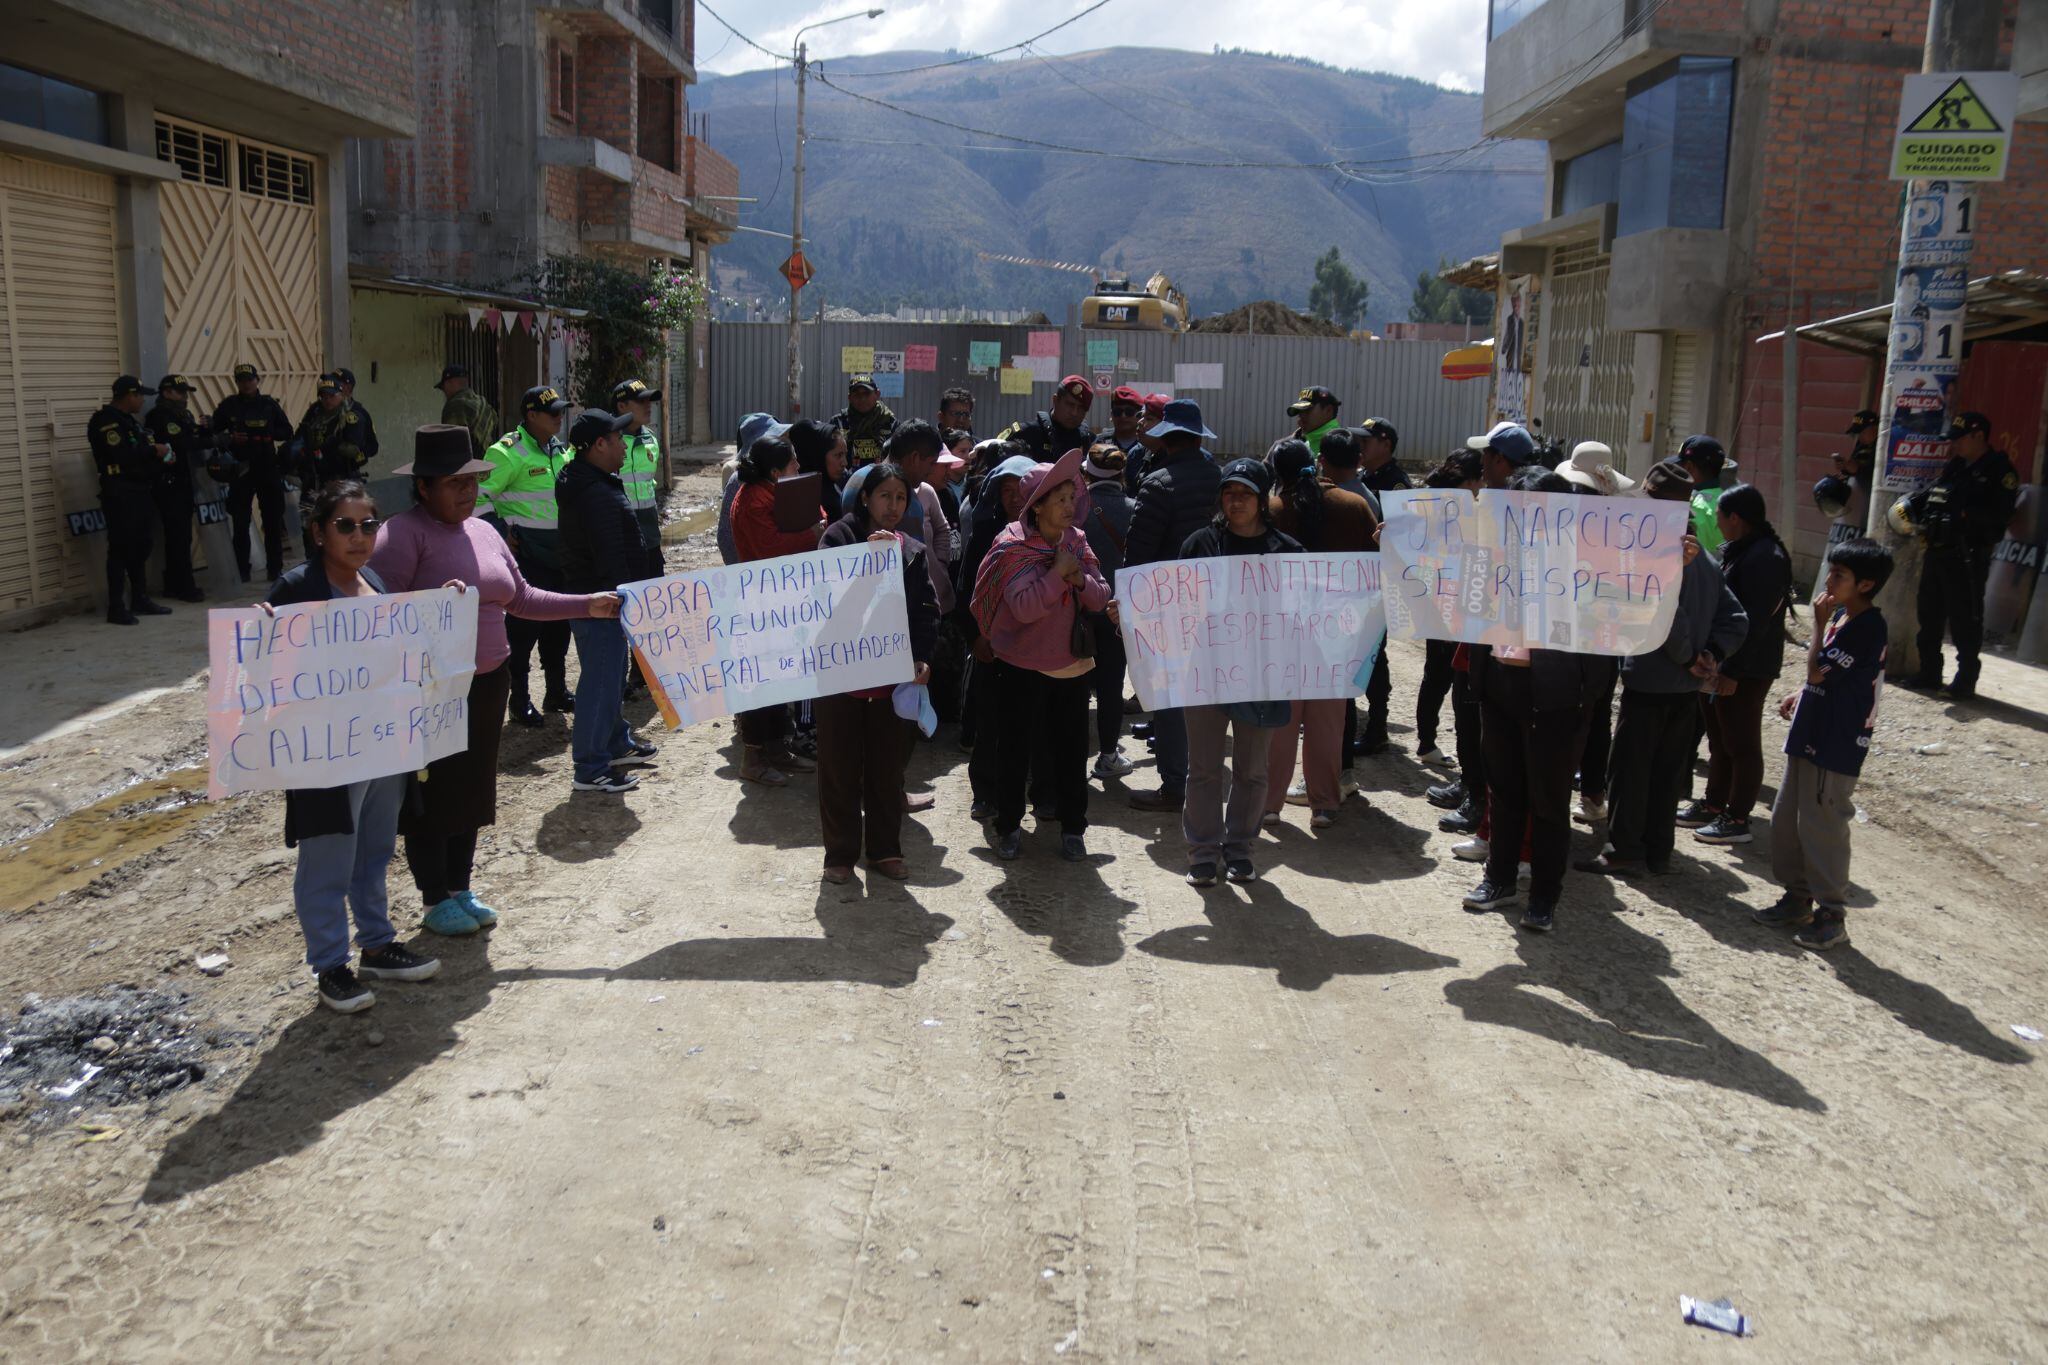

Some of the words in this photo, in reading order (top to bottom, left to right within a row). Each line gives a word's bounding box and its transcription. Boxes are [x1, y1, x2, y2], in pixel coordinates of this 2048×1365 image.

[1905, 164, 1992, 172] TRABAJANDO
[1906, 144, 1996, 155] CUIDADO
[1107, 306, 1129, 320] CAT
[1896, 396, 1941, 409] CHILCA
[1408, 497, 1463, 551] JR
[621, 579, 714, 627] OBRA
[738, 545, 898, 600] PARALIZADA
[1128, 561, 1213, 614] OBRA
[1402, 564, 1459, 598] SE
[1495, 564, 1663, 602] RESPETA
[235, 602, 419, 664] HECHADERO
[434, 599, 454, 632] YA
[631, 624, 688, 657] POR
[705, 592, 834, 643] REUNIÓN
[1134, 620, 1169, 660] NO
[778, 657, 795, 671] DE
[802, 633, 909, 676] HECHADERO
[1826, 647, 1856, 669] QNB
[239, 666, 371, 717] DECIDIO
[402, 651, 434, 684] LA
[1194, 664, 1250, 694] LAS
[231, 716, 361, 771] CALLE
[374, 721, 396, 742] SE
